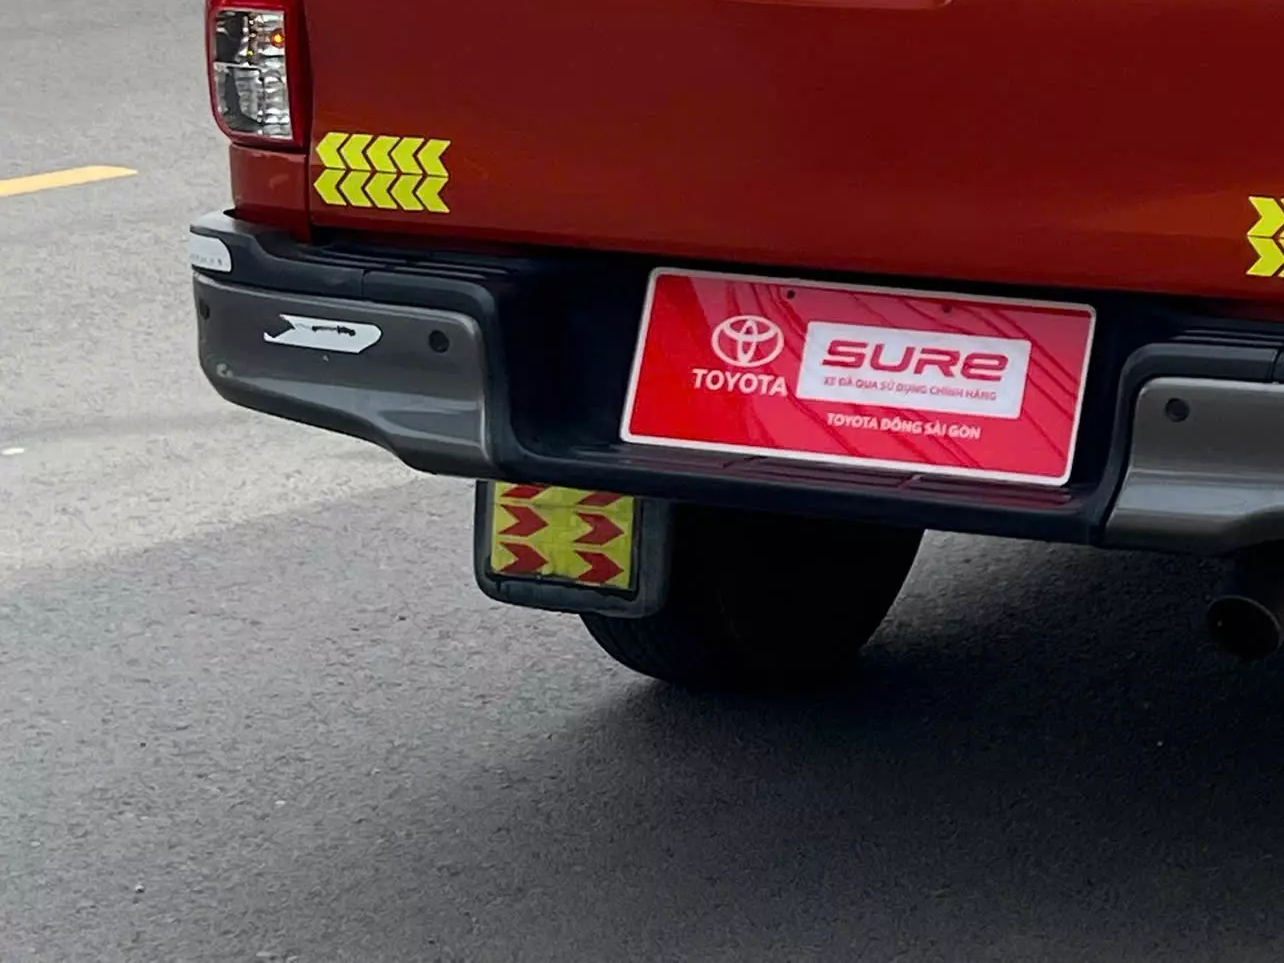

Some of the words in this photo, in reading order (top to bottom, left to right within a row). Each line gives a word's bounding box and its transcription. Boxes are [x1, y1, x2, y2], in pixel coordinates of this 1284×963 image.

[692, 368, 788, 397] TOYOTA
[823, 376, 836, 386] XE
[855, 378, 878, 389] QUA
[827, 412, 878, 430] TOYOTA
[880, 416, 923, 434] ĐÔNG
[924, 420, 946, 436] SÀI
